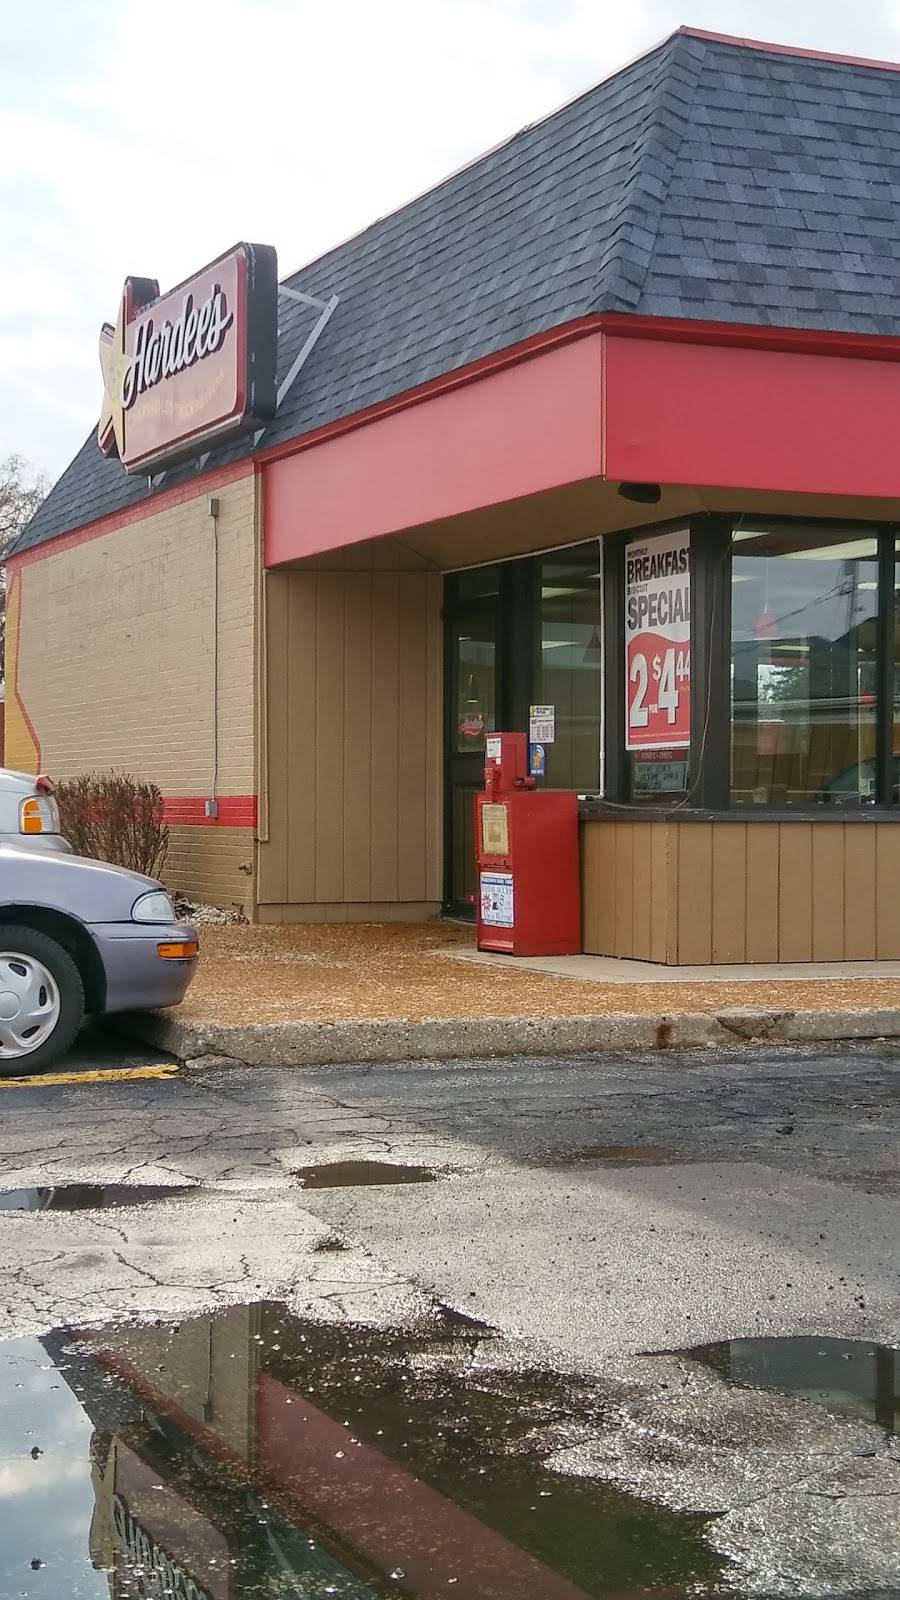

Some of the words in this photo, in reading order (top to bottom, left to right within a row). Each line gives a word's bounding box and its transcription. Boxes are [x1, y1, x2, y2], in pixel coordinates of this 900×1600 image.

[122, 283, 234, 409] Hardee's
[628, 587, 690, 630] SPECIAL
[629, 653, 648, 727] 2
